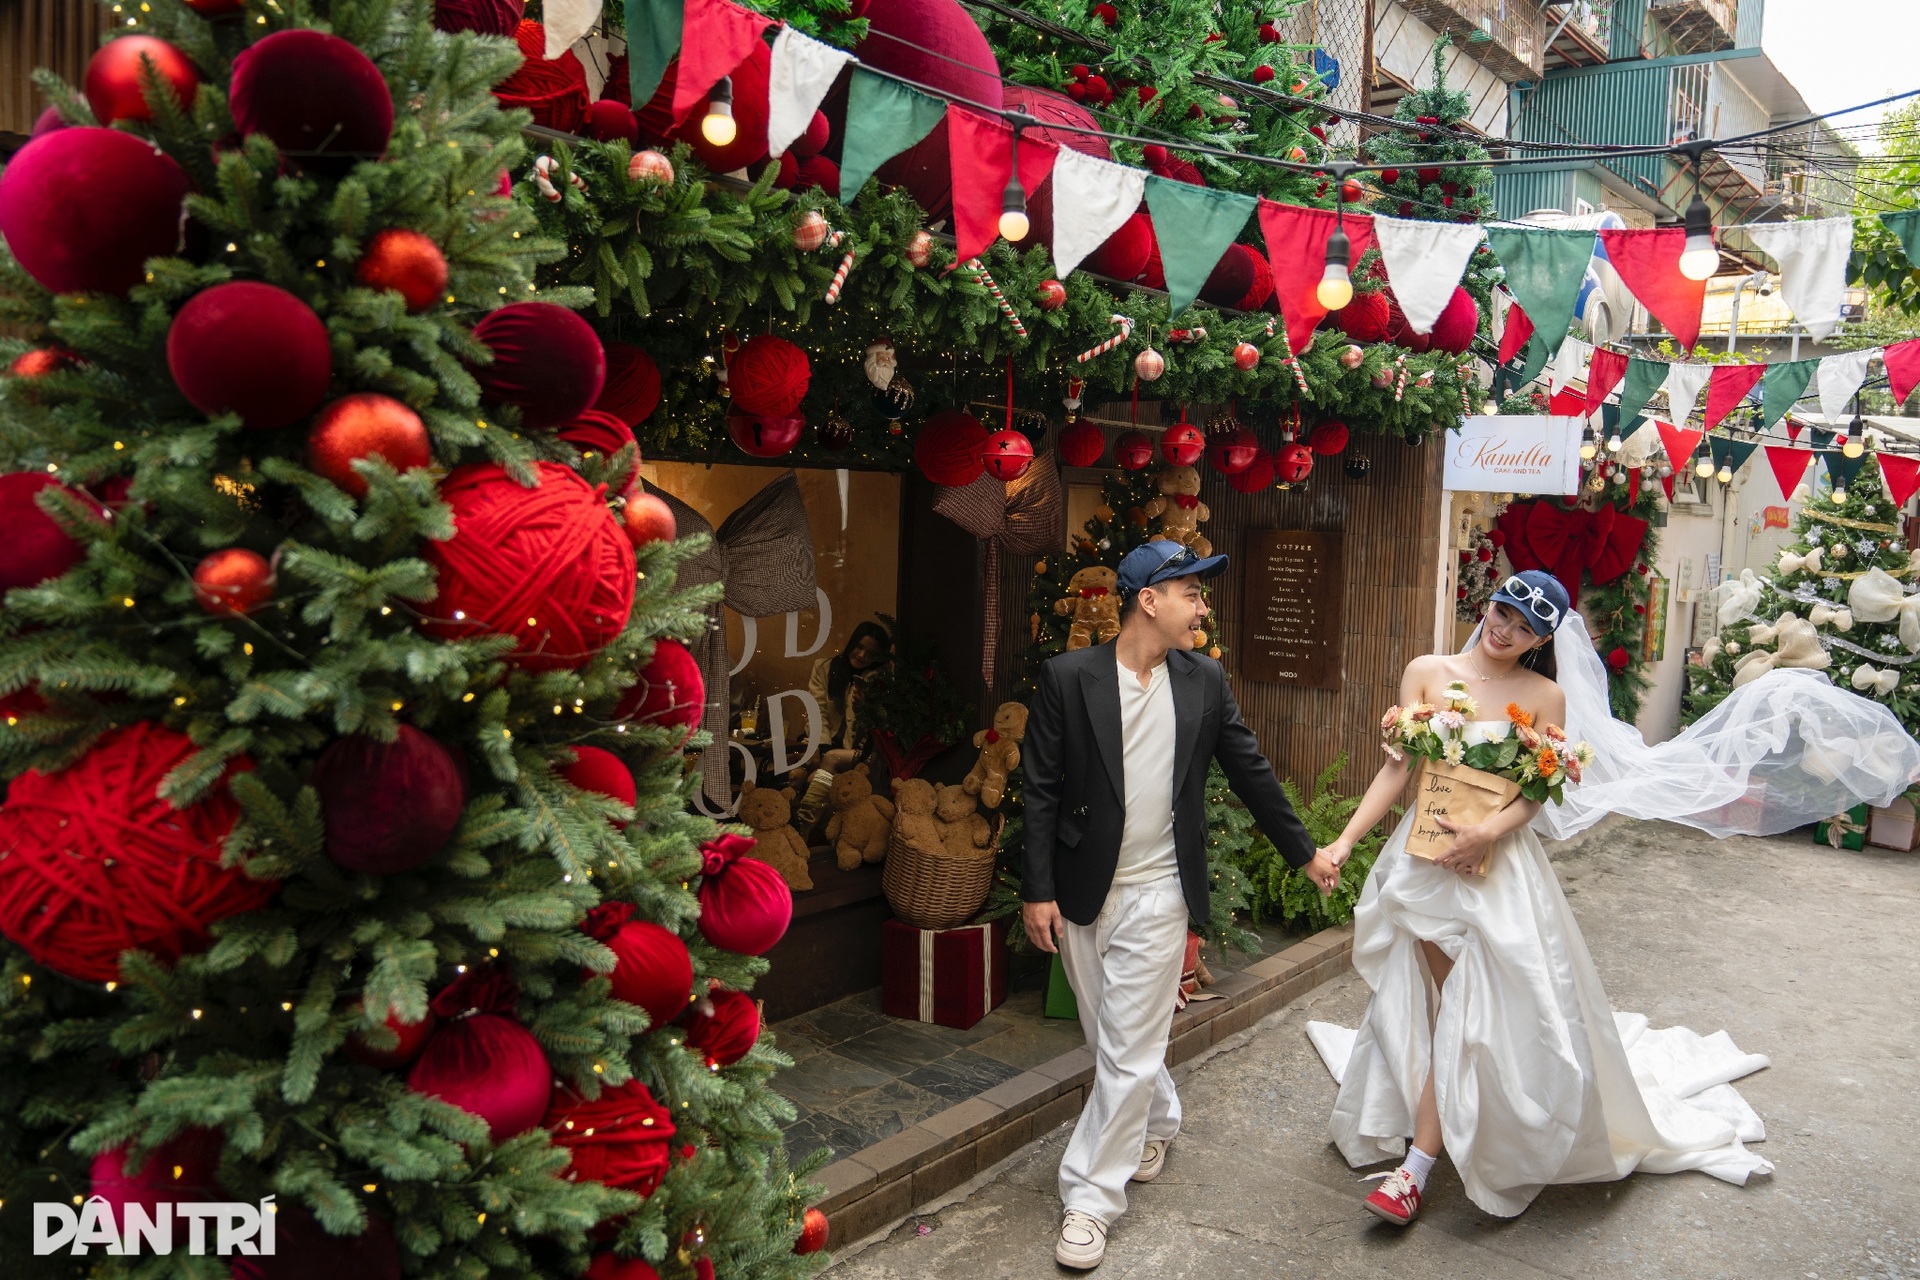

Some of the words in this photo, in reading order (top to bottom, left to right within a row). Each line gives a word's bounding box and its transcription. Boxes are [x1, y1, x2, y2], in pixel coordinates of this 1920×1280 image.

[1453, 434, 1552, 470] Kamilla
[1513, 467, 1527, 475] AND
[1425, 775, 1452, 793] love
[1424, 801, 1448, 816] free
